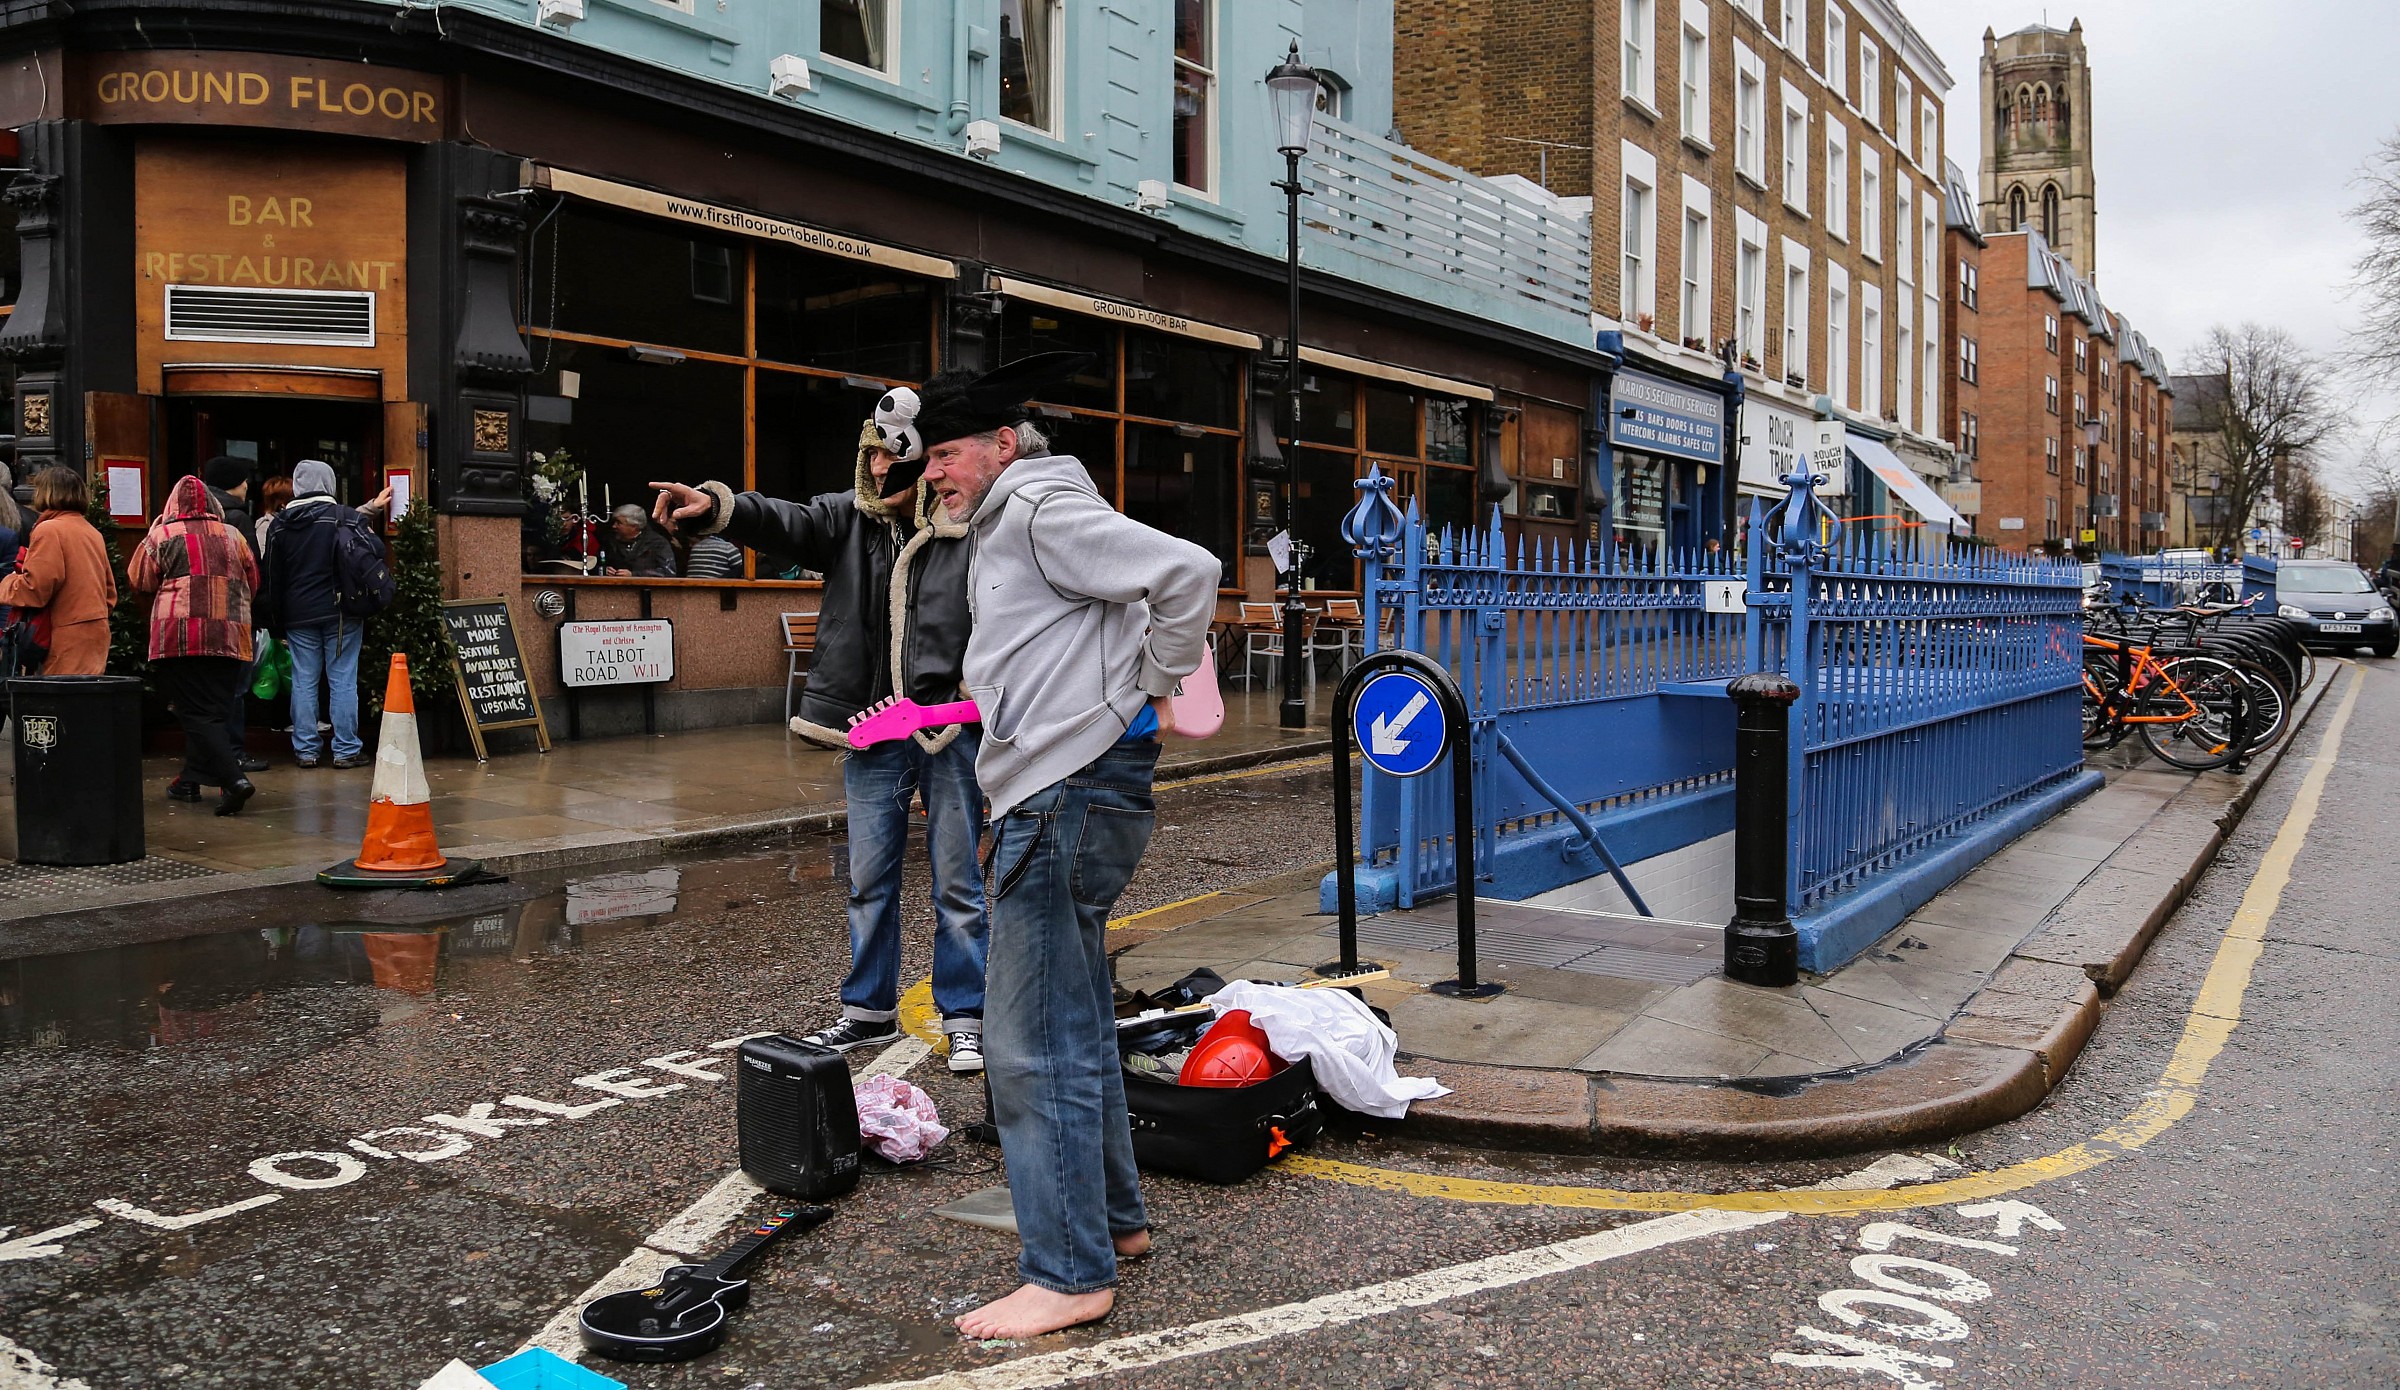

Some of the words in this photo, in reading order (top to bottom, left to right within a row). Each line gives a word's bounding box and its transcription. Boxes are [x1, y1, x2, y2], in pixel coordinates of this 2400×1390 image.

[98, 70, 270, 105] GROUND
[290, 77, 437, 124] FLOOR
[228, 195, 313, 229] BAR
[667, 200, 871, 257] www.firstfloorportobello.co.uk
[262, 234, 275, 248] &
[146, 251, 396, 290] RESTAURANT
[1093, 300, 1135, 319] GROUND
[1138, 309, 1167, 327] FLOOR
[1169, 317, 1188, 331] BAR
[1618, 379, 1651, 401] MARIO'S
[1652, 388, 1687, 410] SECURITY
[1687, 397, 1717, 418] SERVICES
[1647, 413, 1664, 427] BARS
[1666, 418, 1688, 432] DOORS
[1689, 423, 1694, 434] &
[1696, 425, 1713, 438] GATES
[1768, 415, 1794, 450] ROUGH
[1620, 422, 1655, 441] INTERCOMS
[1657, 431, 1681, 447] ALARMS
[1683, 437, 1700, 450] SAFES
[1701, 442, 1716, 453] CCTV
[1814, 446, 1842, 461] ROUGH
[2175, 571, 2223, 580] LADES
[449, 616, 470, 629] WE
[473, 614, 506, 628] HAVE
[572, 625, 583, 633] The
[585, 625, 600, 635] Royal
[602, 624, 624, 634] Borough
[626, 624, 632, 632] of
[634, 624, 662, 633] Kensington
[467, 628, 500, 643] MORE
[614, 637, 635, 645] Chelsea
[458, 644, 500, 660] SEATING
[586, 648, 645, 664] TALBOT
[465, 657, 517, 674] AVAILABLE
[481, 671, 494, 685] IN
[495, 670, 517, 682] OUR
[480, 697, 526, 714] UPSTAIRS
[93, 1102, 554, 1230] LOOK
[1770, 1221, 2020, 1390] LOOK
